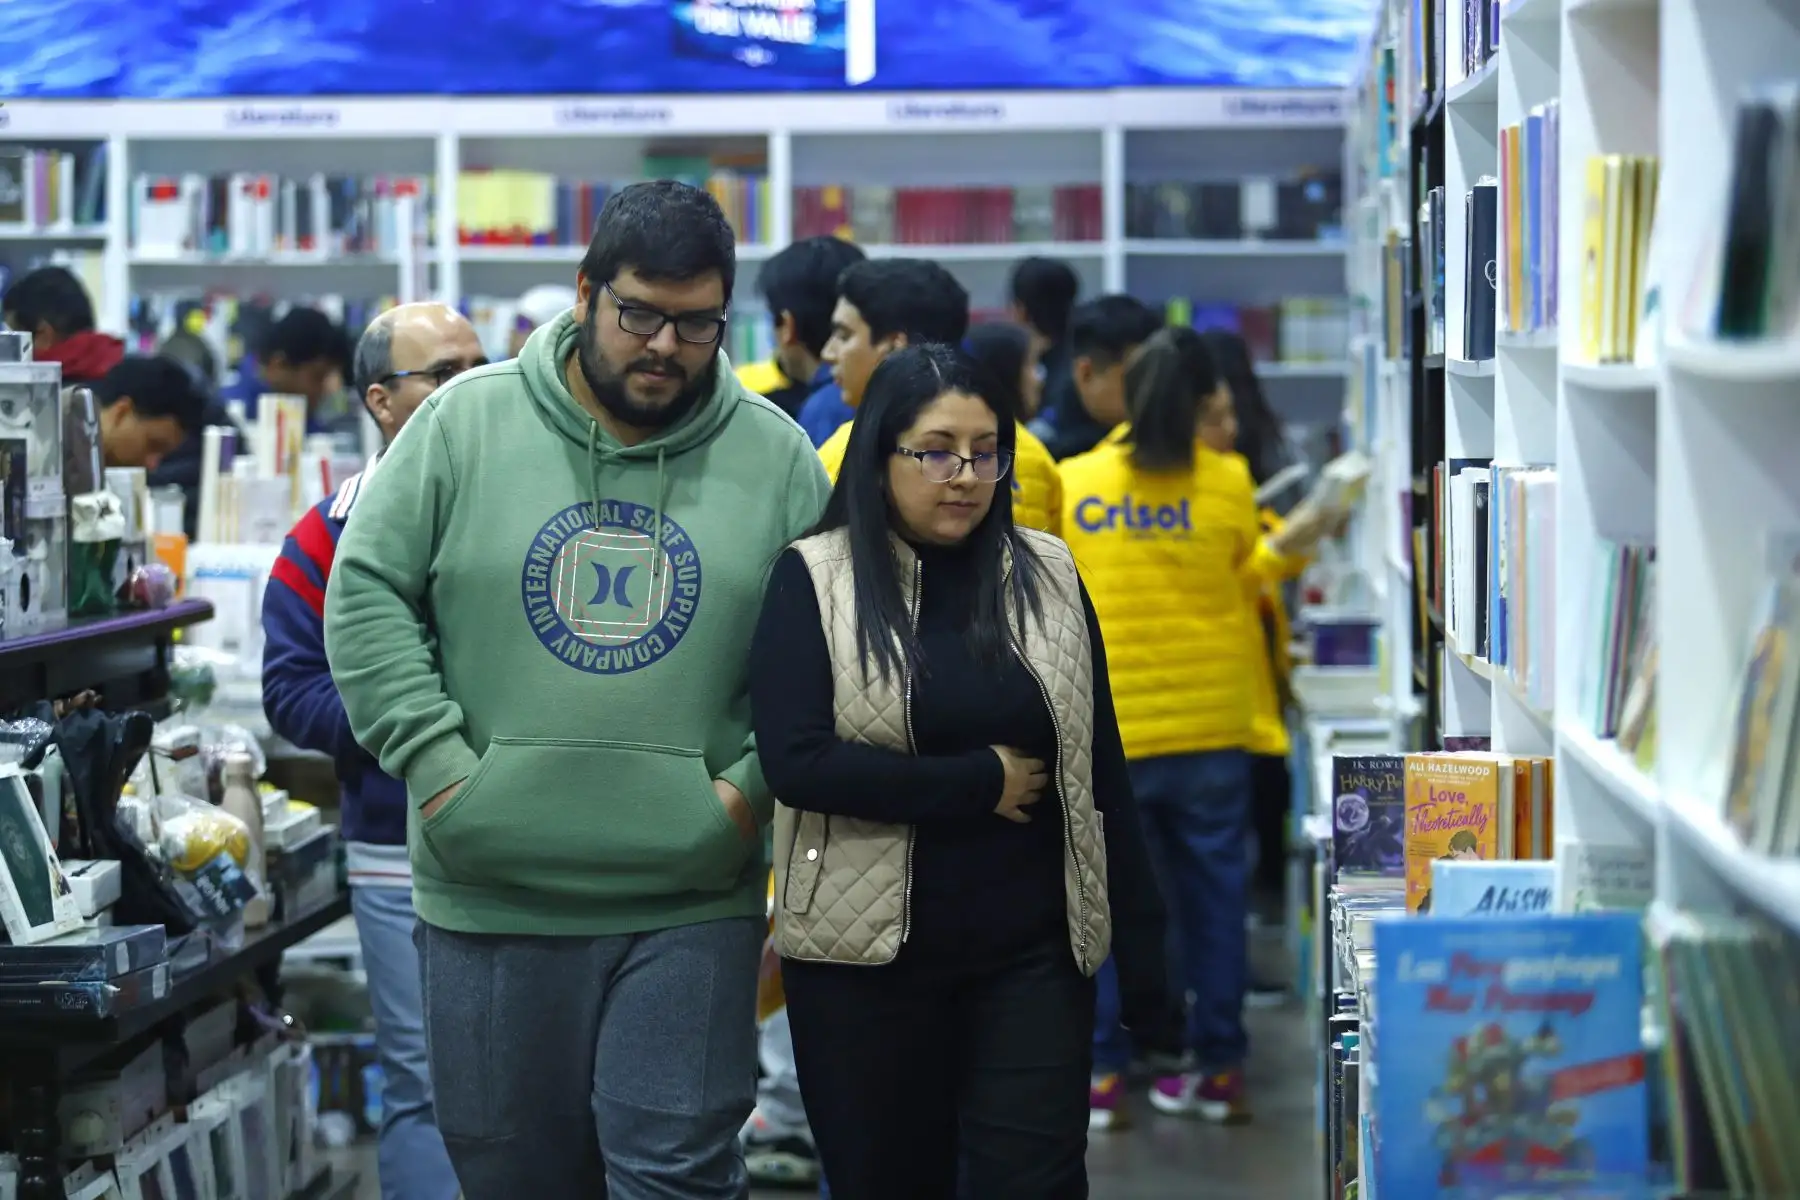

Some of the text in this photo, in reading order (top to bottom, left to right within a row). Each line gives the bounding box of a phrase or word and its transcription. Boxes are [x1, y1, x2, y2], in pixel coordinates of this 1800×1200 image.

[525, 503, 698, 670] INTERNATIONAL SURF SUPPLY COMPANY
[1409, 762, 1490, 776] ALI HAZELWOOD
